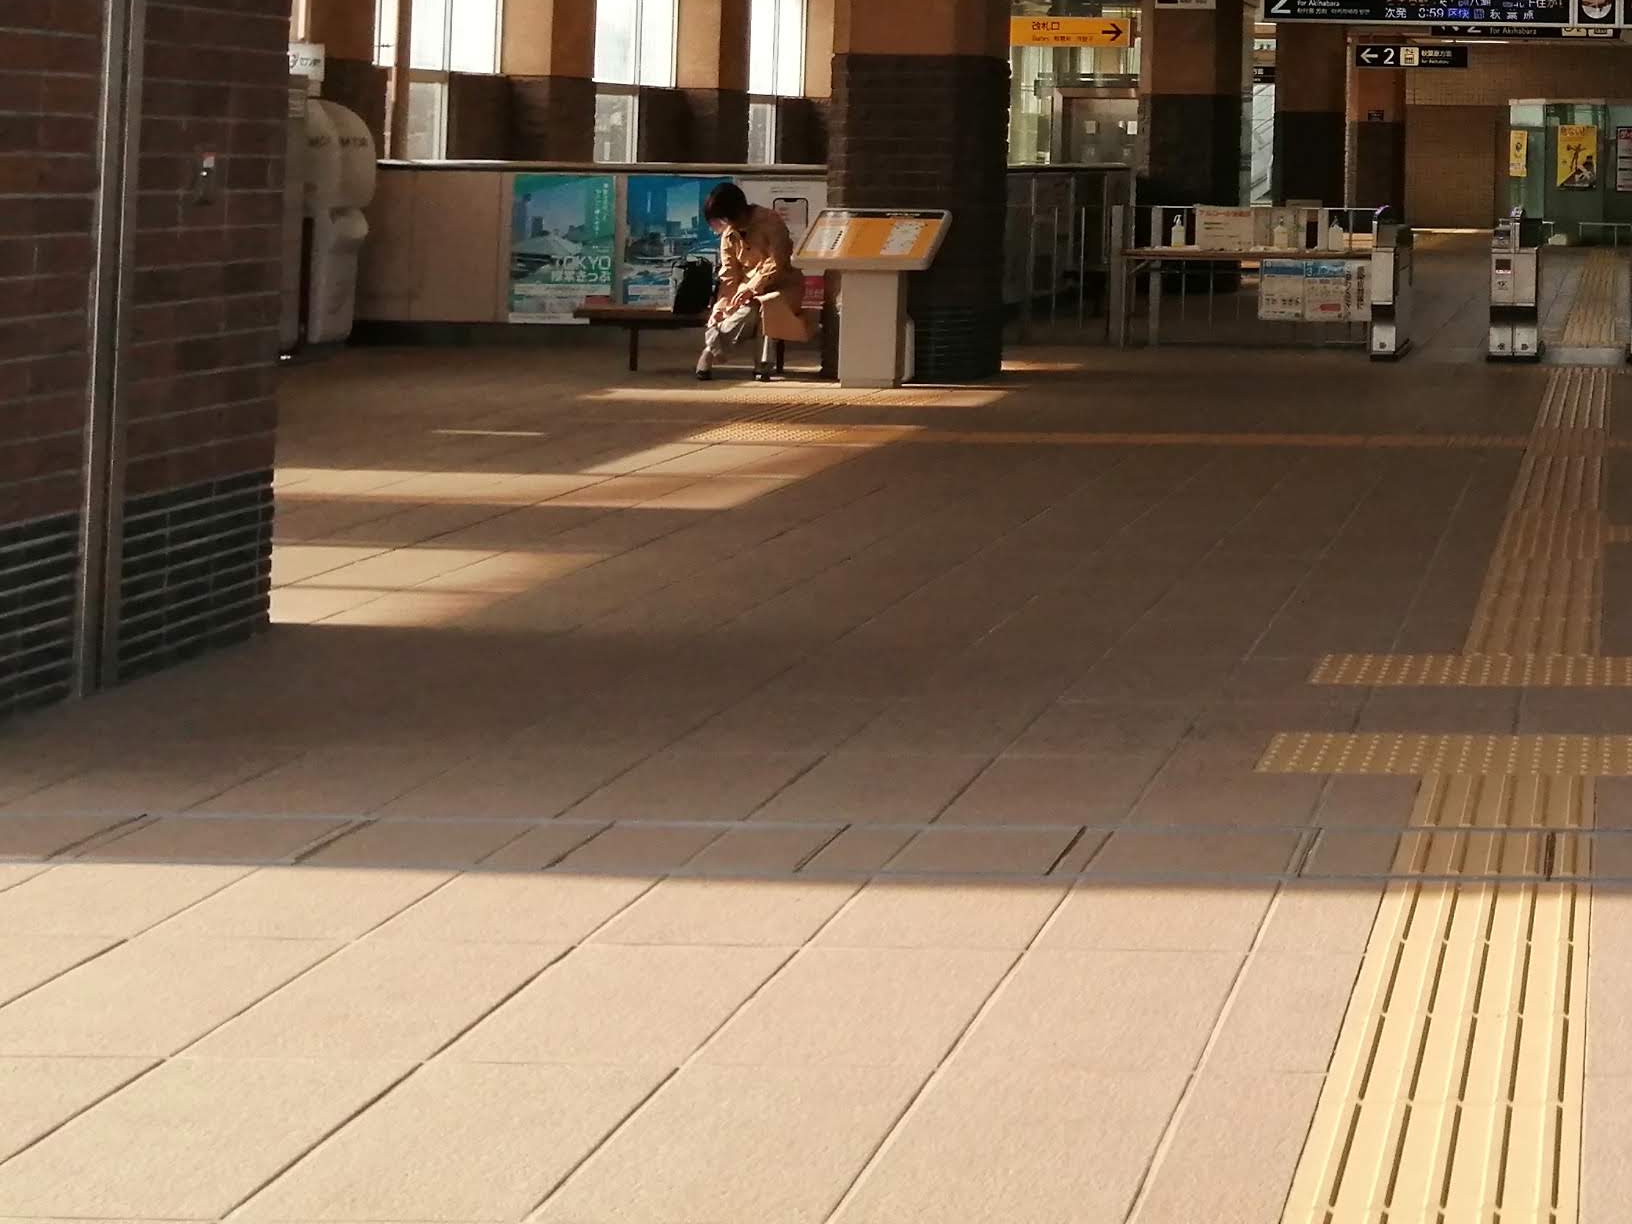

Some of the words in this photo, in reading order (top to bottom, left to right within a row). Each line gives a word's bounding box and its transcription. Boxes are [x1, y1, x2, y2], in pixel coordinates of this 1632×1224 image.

[1032, 21, 1060, 31] 改札口
[1383, 48, 1395, 65] 2
[552, 255, 612, 270] TOKYO
